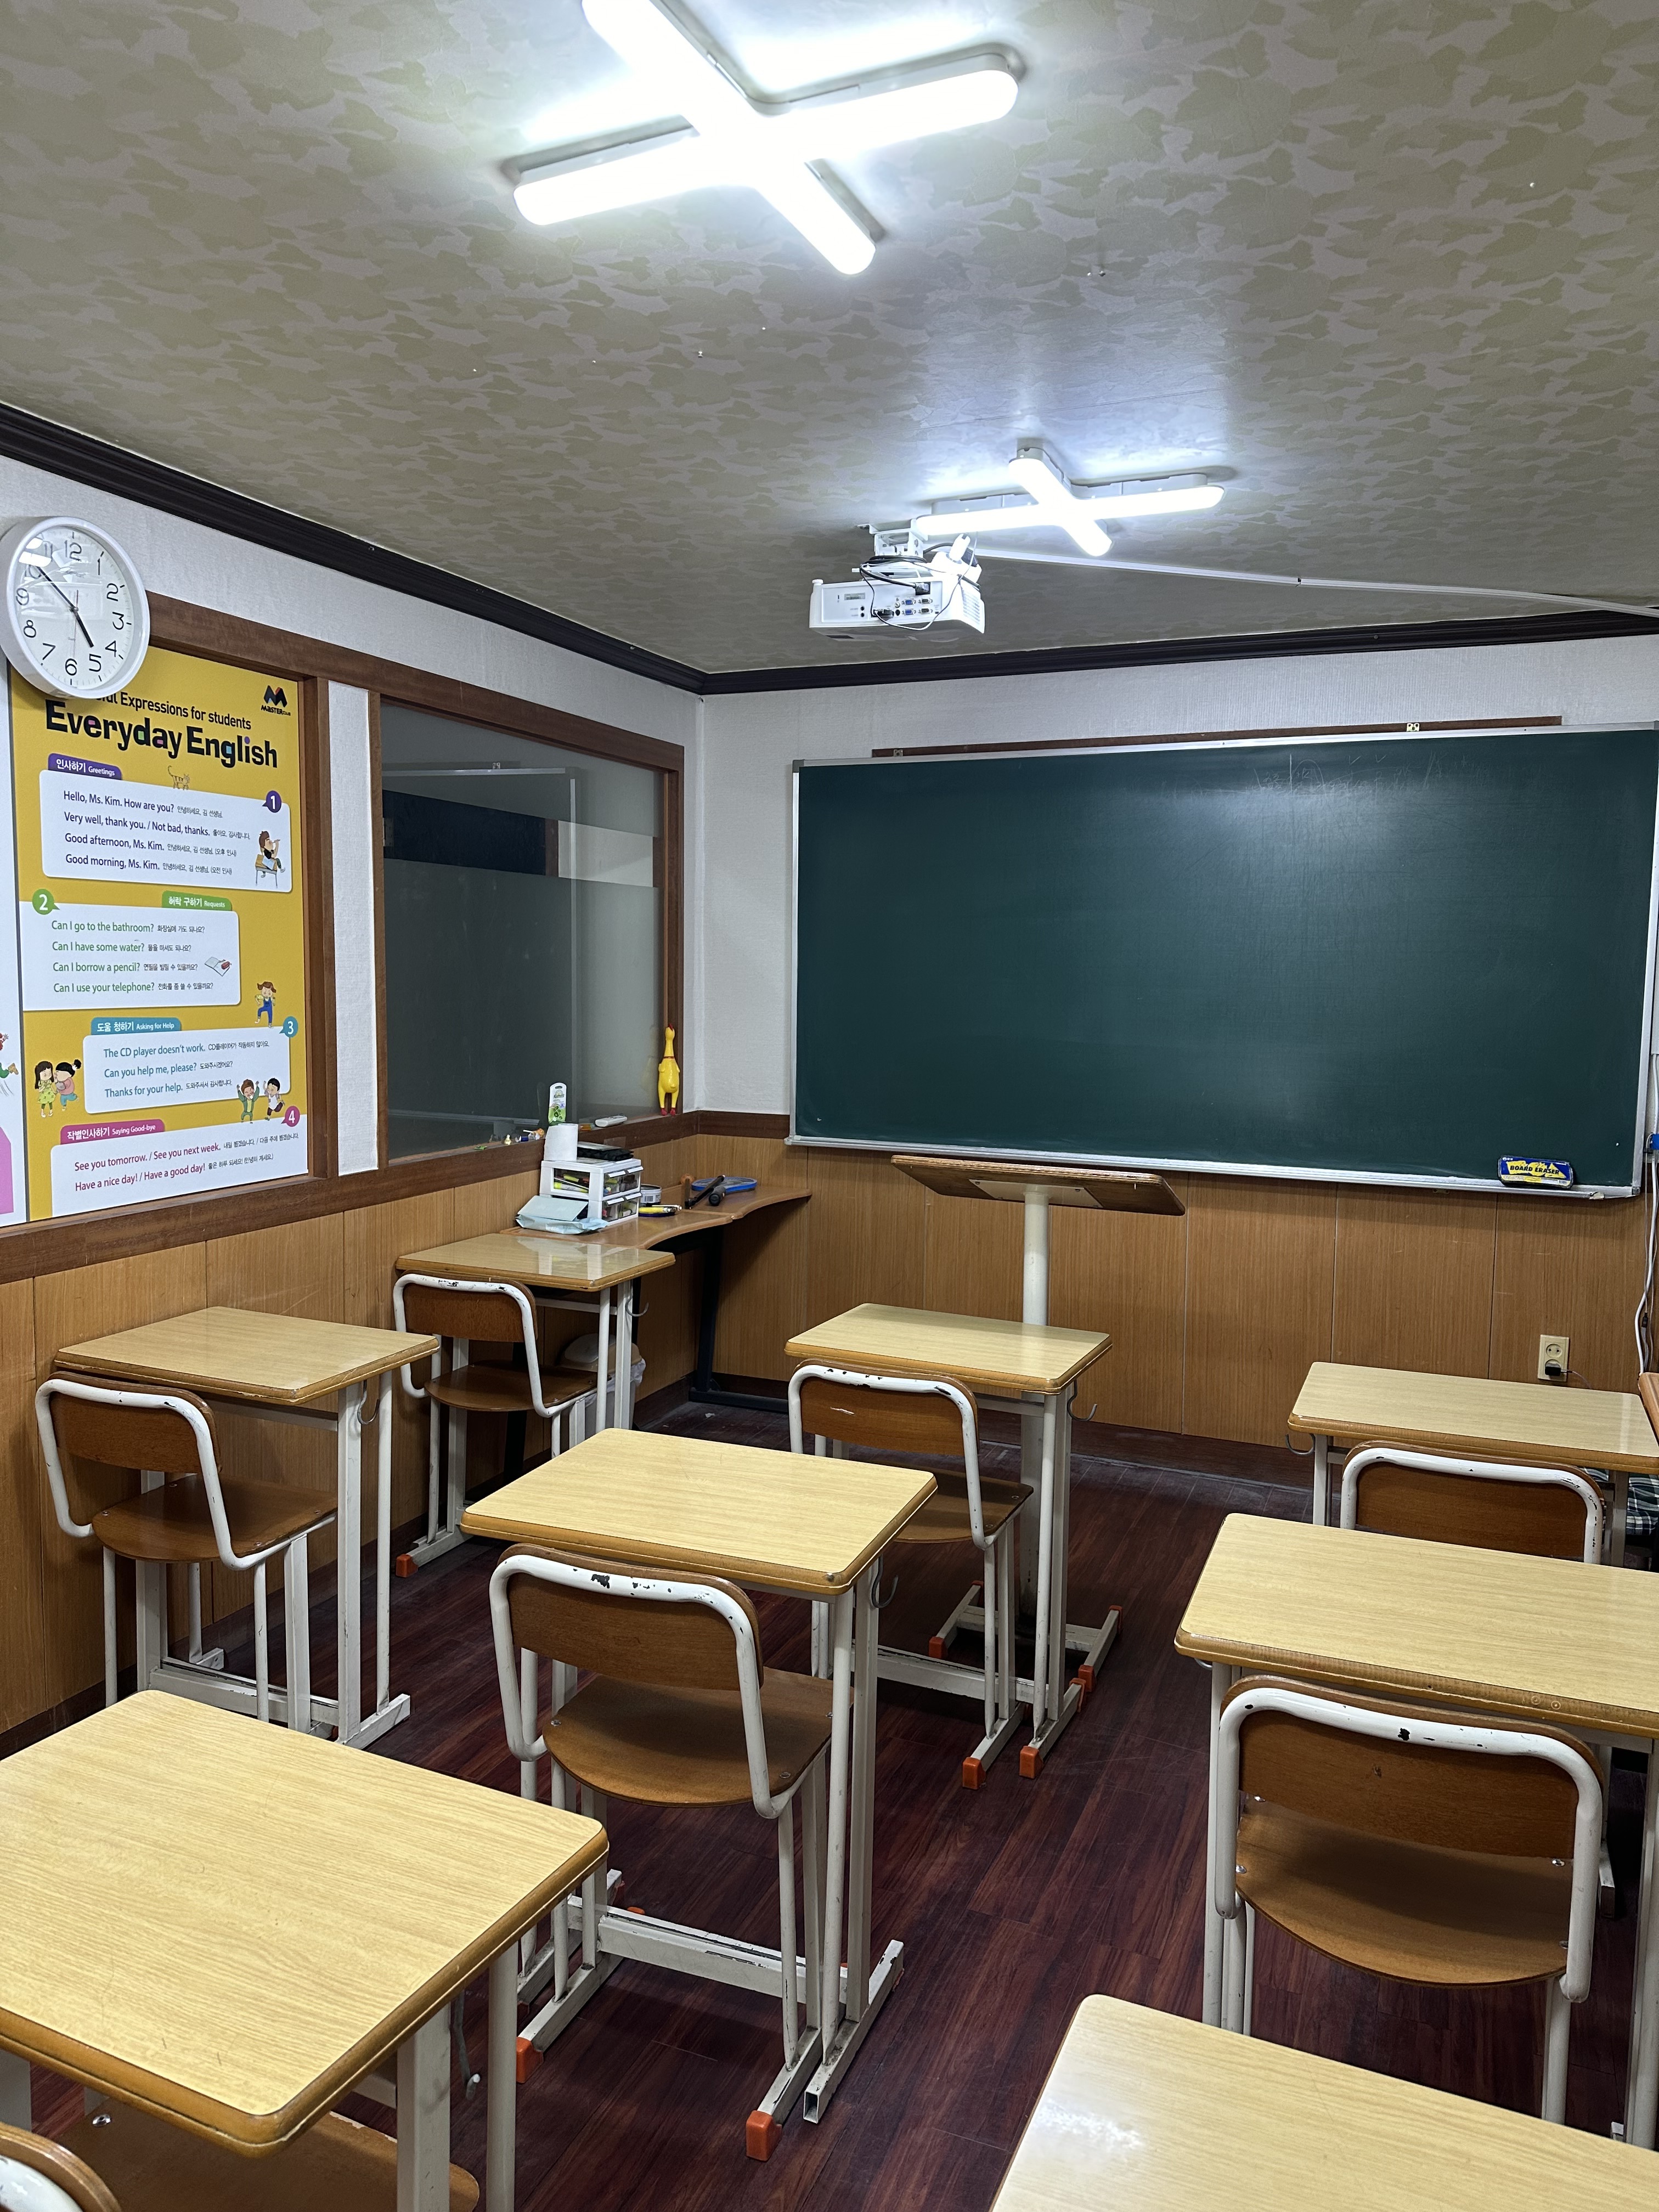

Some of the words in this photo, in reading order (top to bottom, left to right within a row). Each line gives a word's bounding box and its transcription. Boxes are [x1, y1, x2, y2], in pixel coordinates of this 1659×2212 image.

[65, 540, 82, 561] 12
[97, 558, 100, 575] 1
[16, 588, 30, 606] 9
[106, 583, 119, 602] 2
[23, 619, 37, 638] 8
[112, 612, 125, 630] 3
[42, 642, 56, 661] 7
[105, 640, 117, 658] 4
[65, 658, 77, 676] 6
[88, 653, 102, 673] 5
[121, 691, 189, 718] Expressions
[191, 706, 206, 721] for
[208, 712, 252, 730] students
[46, 699, 182, 759] Everyday
[187, 725, 278, 769] English
[56, 758, 86, 773] 인사하기
[88, 766, 115, 777] Greetings
[64, 790, 87, 804] Hello,
[89, 793, 103, 804] Ms.
[105, 795, 122, 806] Kim.
[124, 798, 142, 809] How
[156, 804, 174, 813] you?
[270, 795, 275, 810] 1
[64, 811, 83, 825] Very
[84, 814, 104, 826] well,
[105, 816, 128, 827] thank
[129, 820, 146, 830] you.
[147, 821, 150, 830] /
[152, 821, 166, 831] Not
[167, 823, 183, 834] bad,
[184, 825, 210, 836] thanks.
[65, 833, 88, 844] Good
[90, 835, 132, 849] afternoon,
[133, 839, 146, 849] Ms.
[148, 840, 165, 851] Kim.
[66, 854, 89, 865] Good
[91, 857, 127, 870] morning,
[128, 859, 142, 869] Ms.
[143, 860, 160, 870] Kim.
[39, 894, 48, 911] 2
[168, 896, 182, 906] 허락
[183, 897, 202, 907] 구하기
[204, 900, 225, 909] Requests
[52, 920, 68, 930] Can
[70, 921, 72, 930] I
[74, 922, 85, 933] go
[87, 922, 96, 931] to
[97, 922, 111, 931] the
[112, 922, 154, 933] bathroom?
[52, 941, 69, 951] Can
[70, 941, 73, 951] I
[75, 941, 94, 951] have
[119, 943, 145, 952] water?
[53, 962, 69, 972] Can
[71, 962, 74, 972] I
[75, 962, 105, 972] borrow
[113, 962, 140, 974] pencil?
[53, 983, 70, 992] Can
[72, 983, 75, 992] I
[92, 984, 111, 994] your
[112, 981, 155, 994] telephone?
[97, 1022, 111, 1032] 도움
[114, 1021, 134, 1032] 청하기
[162, 1022, 174, 1030] Help
[287, 1020, 294, 1035] 3
[103, 1048, 119, 1058] The
[120, 1047, 132, 1057] CD
[133, 1046, 156, 1058] player
[186, 1043, 206, 1053] work.
[104, 1068, 120, 1077] Can
[121, 1069, 136, 1079] you
[137, 1065, 154, 1077] help
[155, 1066, 169, 1075] me,
[171, 1062, 197, 1075] please?
[105, 1086, 133, 1098] Thanks
[134, 1085, 145, 1095] for
[146, 1086, 163, 1096] your
[165, 1082, 183, 1093] help.
[288, 1110, 296, 1124] 4
[67, 1126, 110, 1141] 작별인사하기
[112, 1127, 130, 1136] Saying
[130, 1124, 156, 1133] Good-bye
[74, 1161, 89, 1171] See
[91, 1160, 106, 1172] you
[108, 1154, 148, 1166] tomorrow.
[149, 1152, 153, 1161] /
[154, 1151, 167, 1160] See
[168, 1149, 182, 1160] you
[183, 1146, 199, 1156] next
[200, 1142, 221, 1153] week.
[75, 1182, 96, 1192] Have
[97, 1180, 102, 1188] a
[104, 1177, 120, 1187] nice
[121, 1173, 138, 1185] day!
[139, 1172, 143, 1182] /
[144, 1171, 162, 1181] Have
[170, 1165, 189, 1178] good
[190, 1163, 206, 1173] day!
[1534, 1167, 1560, 1175] ERASER
